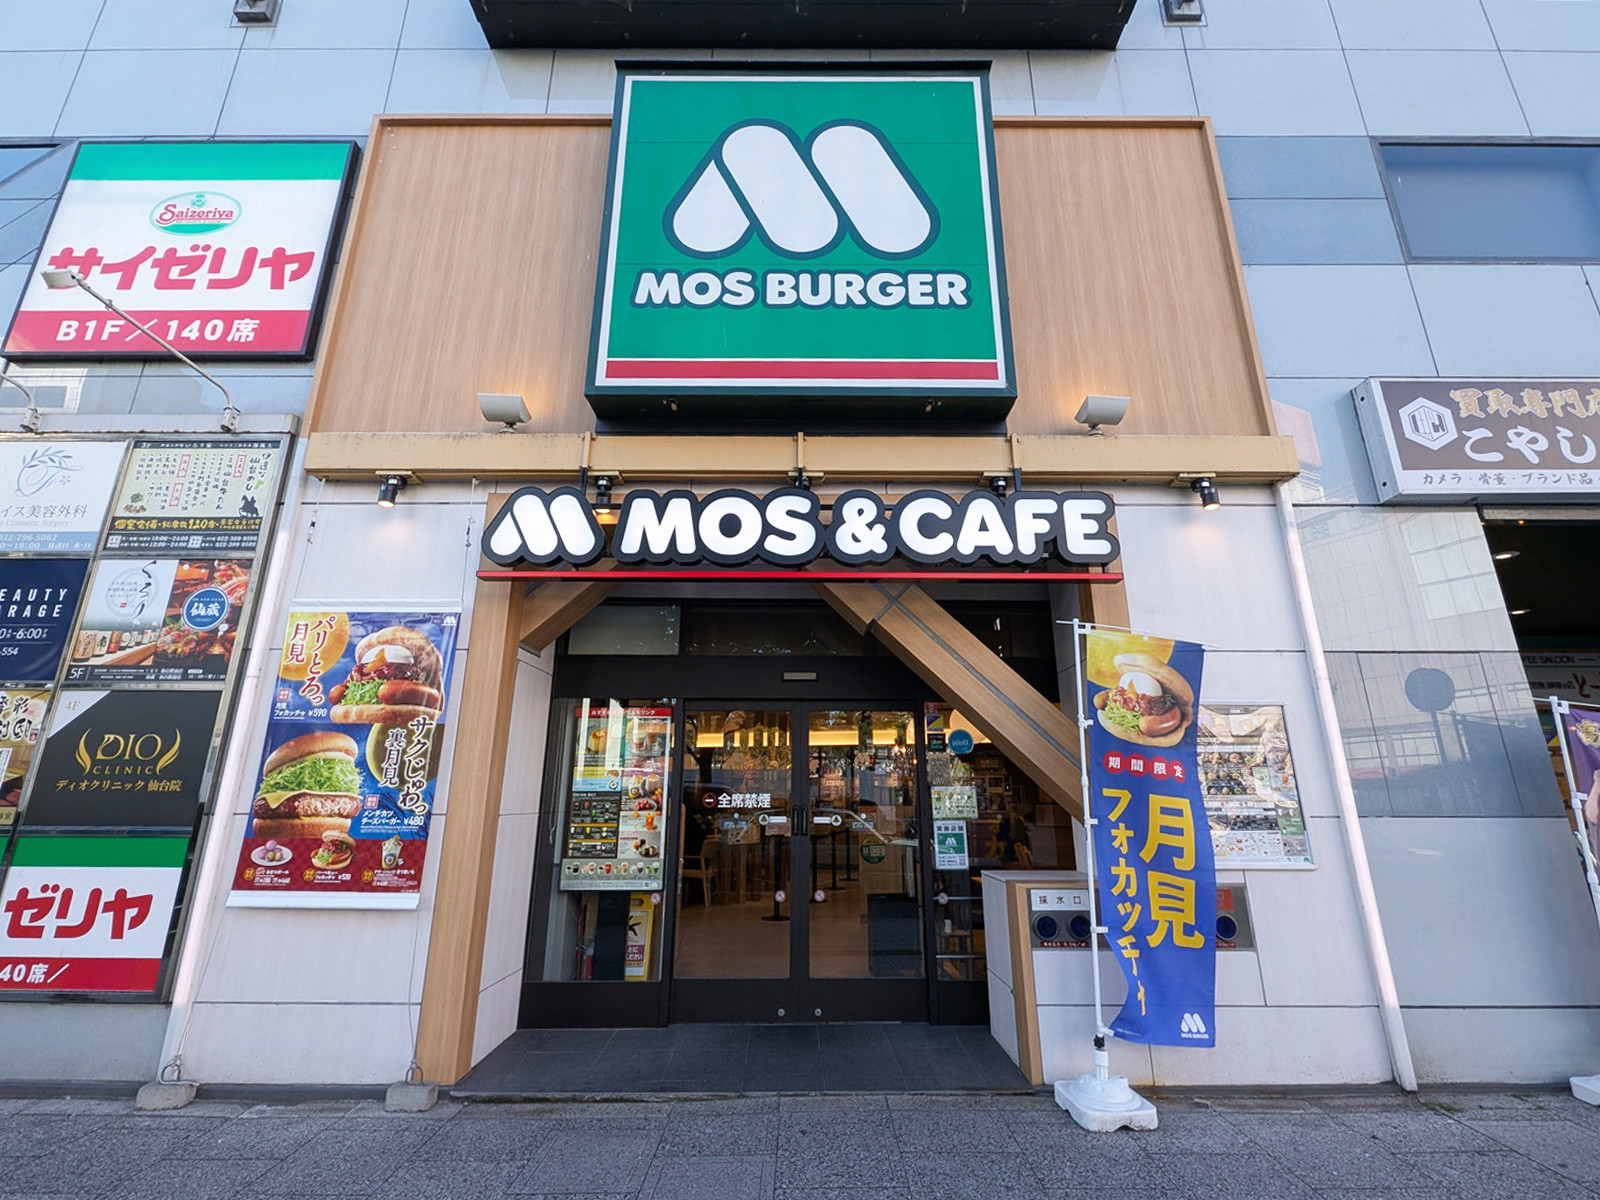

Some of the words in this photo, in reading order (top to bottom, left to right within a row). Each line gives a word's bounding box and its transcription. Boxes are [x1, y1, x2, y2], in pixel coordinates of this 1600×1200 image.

[157, 203, 234, 223] Saizeriya
[47, 244, 315, 290] サイゼリヤ
[634, 271, 753, 306] MOS
[766, 272, 968, 306] BURGER
[1461, 425, 1597, 465] こやし
[1, 504, 88, 518] イス美容外科
[620, 496, 818, 557] MOS
[834, 496, 888, 556] &
[899, 496, 1112, 557] CAFE
[0, 604, 62, 618] RAGE
[284, 622, 309, 664] 月見
[69, 667, 85, 679] 5F
[300, 615, 336, 705] パリとろっ
[96, 733, 163, 761] DIO
[380, 728, 407, 786] 裏月見
[951, 738, 970, 747] Wolt
[92, 765, 155, 775] CLINIC
[400, 716, 434, 814] サクじゅわっ
[1107, 755, 1184, 779] 期間限定
[362, 810, 395, 818] メンチカツ
[717, 793, 772, 809] 全席禁煙
[1138, 793, 1205, 950] 月見
[4, 884, 154, 939] ゼリヤ
